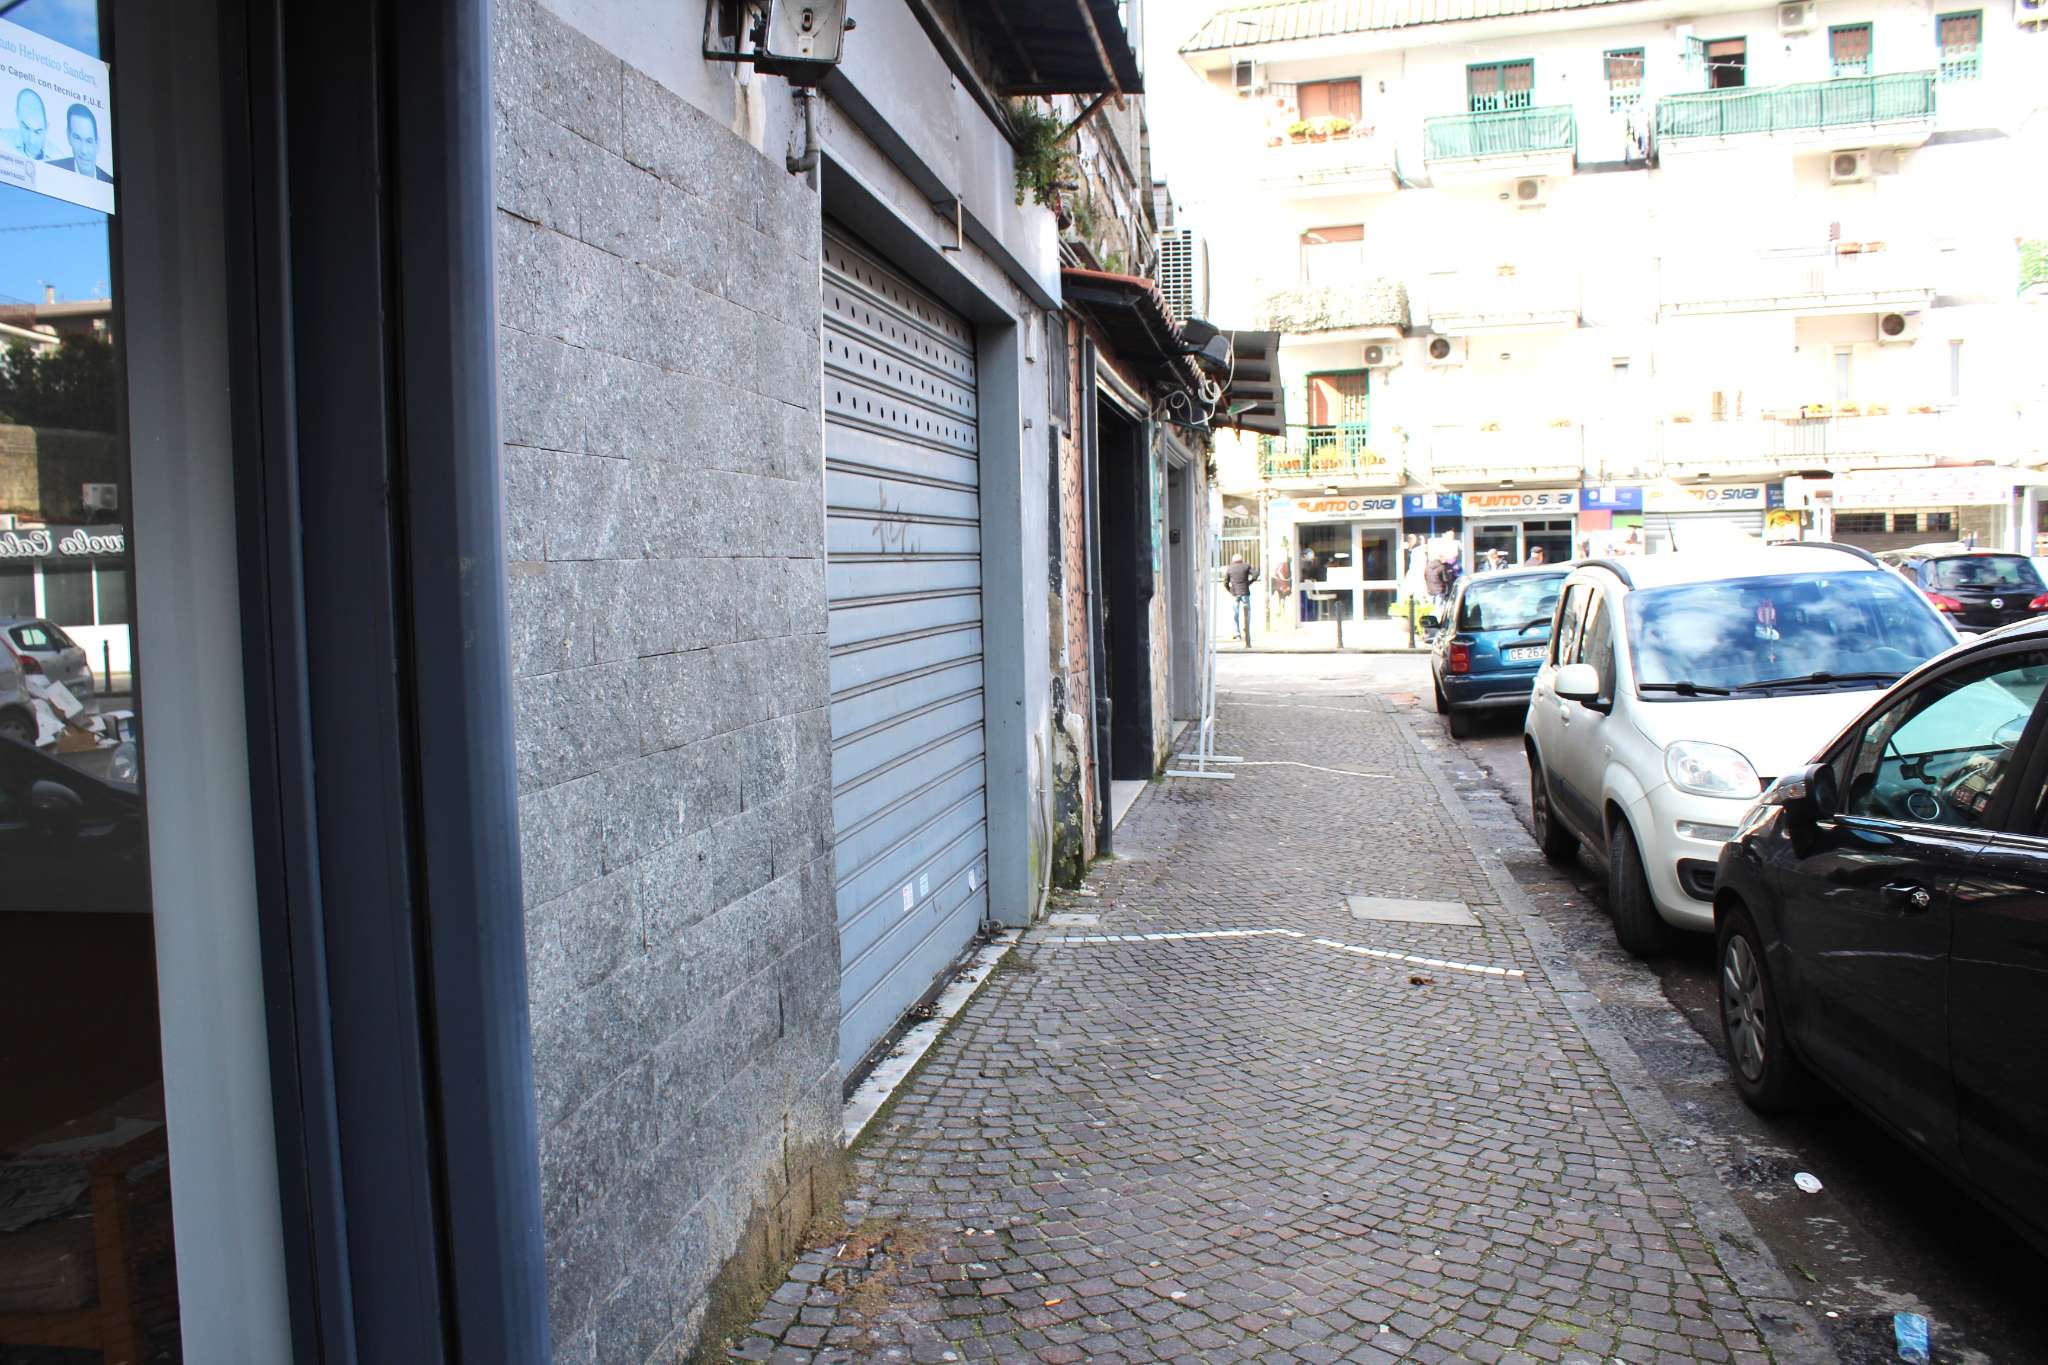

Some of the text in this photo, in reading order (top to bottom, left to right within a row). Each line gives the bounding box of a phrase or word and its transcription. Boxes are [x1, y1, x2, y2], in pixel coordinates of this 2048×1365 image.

[8, 66, 36, 83] Capelli
[38, 77, 52, 90] con
[54, 84, 81, 101] tecnica
[1468, 495, 1520, 507] PUNTO
[1510, 646, 1546, 660] CE 262
